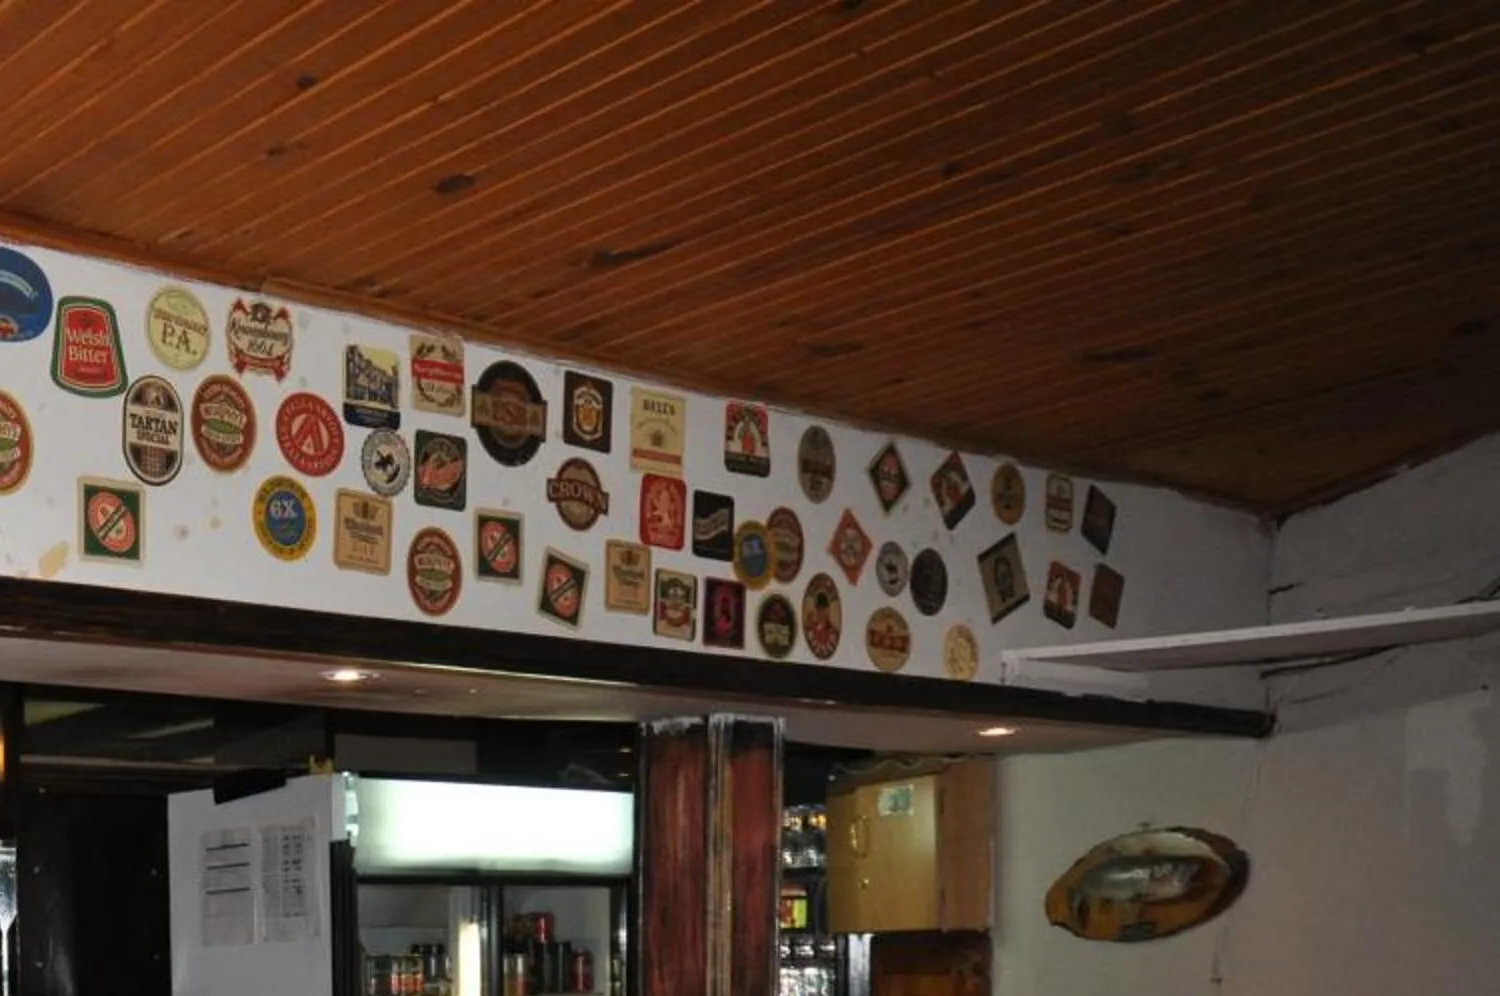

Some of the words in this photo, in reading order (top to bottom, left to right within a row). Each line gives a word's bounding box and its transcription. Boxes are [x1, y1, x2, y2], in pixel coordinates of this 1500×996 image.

[67, 328, 111, 347] Welsh
[68, 345, 109, 364] Bitter
[129, 413, 178, 435] TARTAN
[271, 498, 297, 519] 6X
